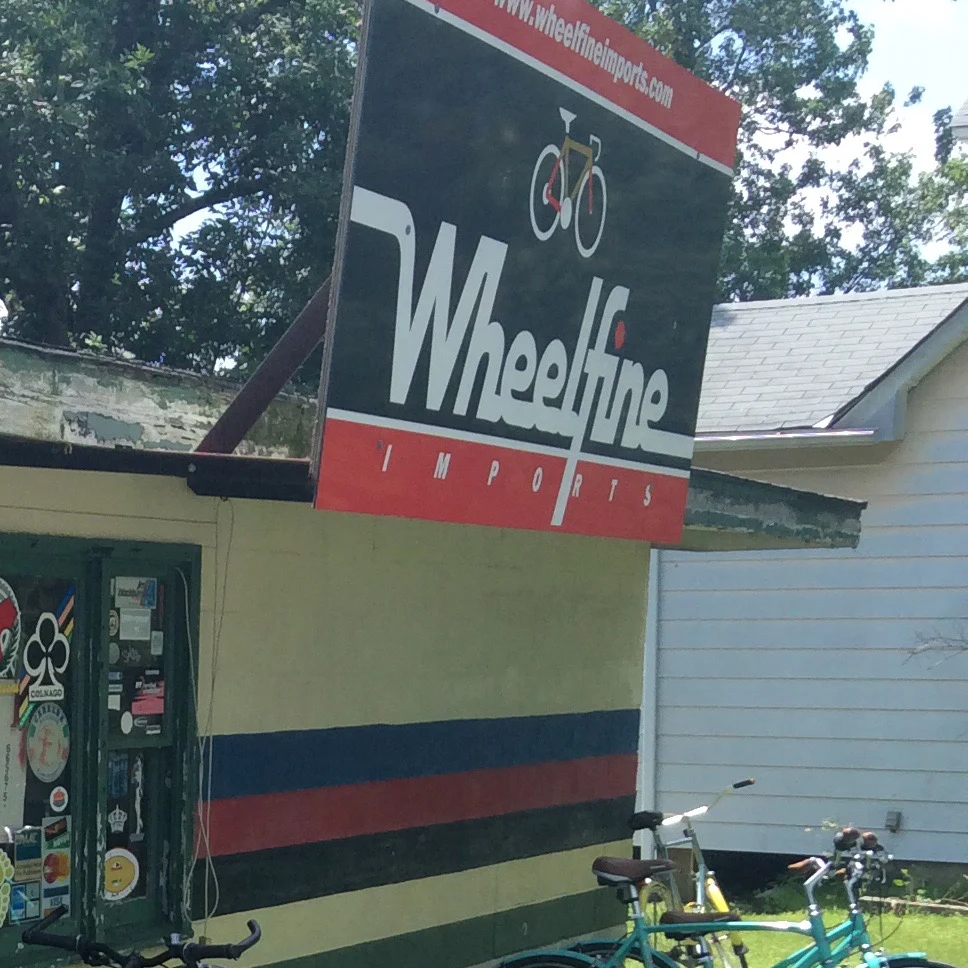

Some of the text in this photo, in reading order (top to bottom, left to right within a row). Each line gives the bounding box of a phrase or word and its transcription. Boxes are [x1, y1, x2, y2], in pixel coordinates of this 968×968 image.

[351, 185, 695, 526] Wheelfine
[381, 443, 653, 506] IMPORTS
[30, 689, 62, 699] COLNAGO
